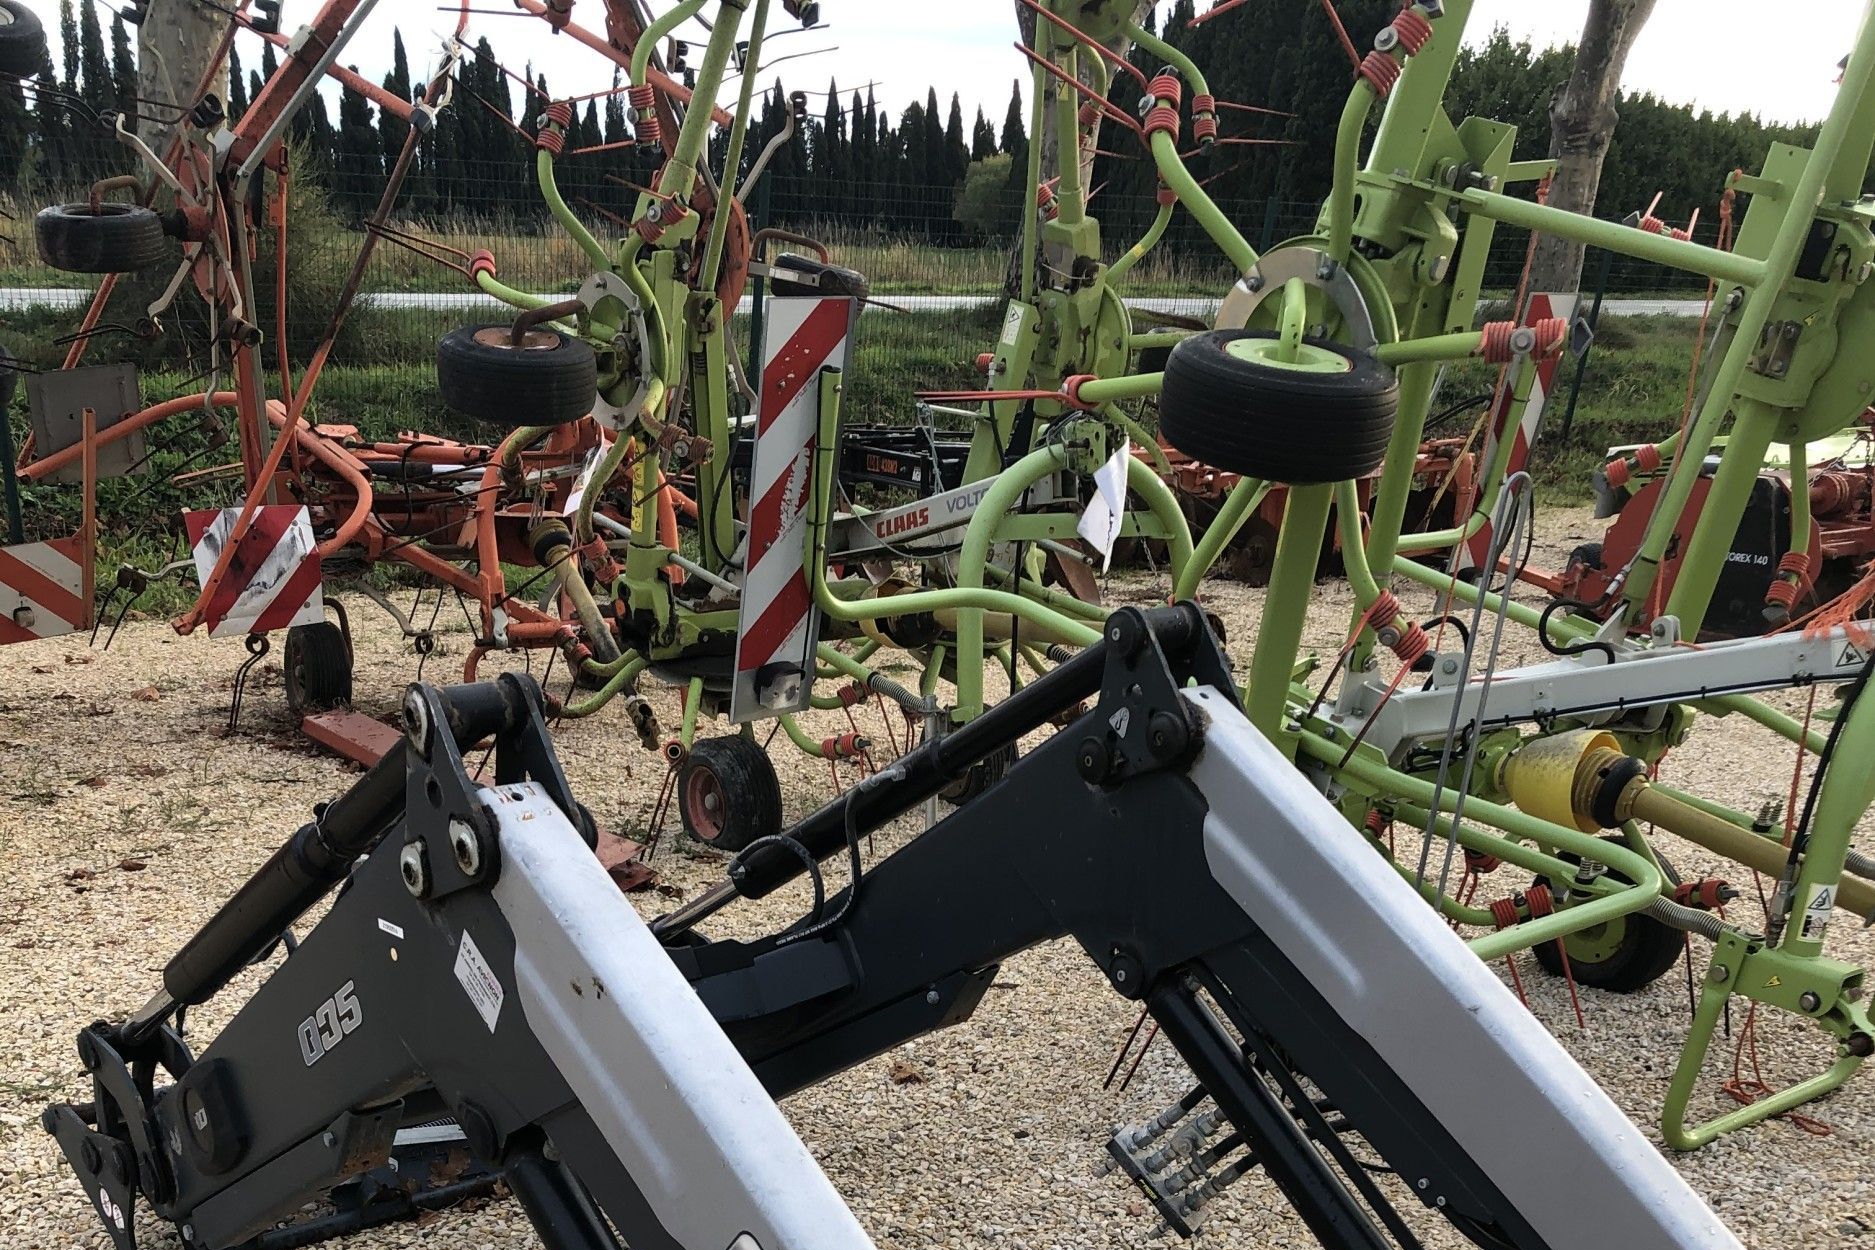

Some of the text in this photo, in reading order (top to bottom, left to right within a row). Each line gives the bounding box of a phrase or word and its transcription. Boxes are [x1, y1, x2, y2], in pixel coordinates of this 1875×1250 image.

[876, 507, 929, 538] CLAAS
[1728, 552, 1768, 565] OREX 140
